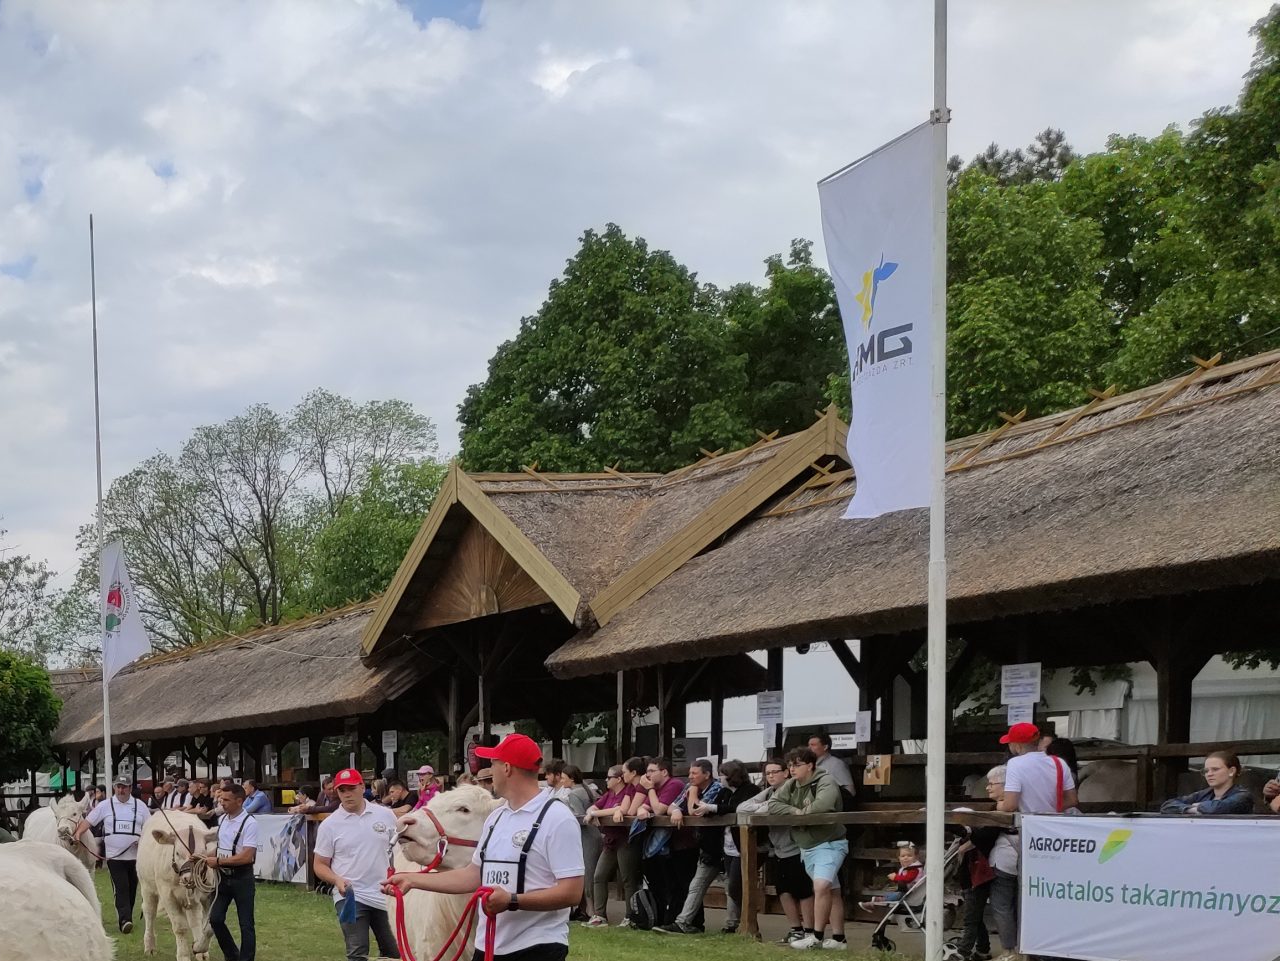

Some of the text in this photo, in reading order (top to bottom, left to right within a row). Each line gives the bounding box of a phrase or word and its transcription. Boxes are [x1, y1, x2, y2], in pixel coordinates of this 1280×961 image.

[1028, 836, 1097, 854] AGROFEED
[485, 870, 510, 885] 1303
[1027, 875, 1115, 904] Hivatalos
